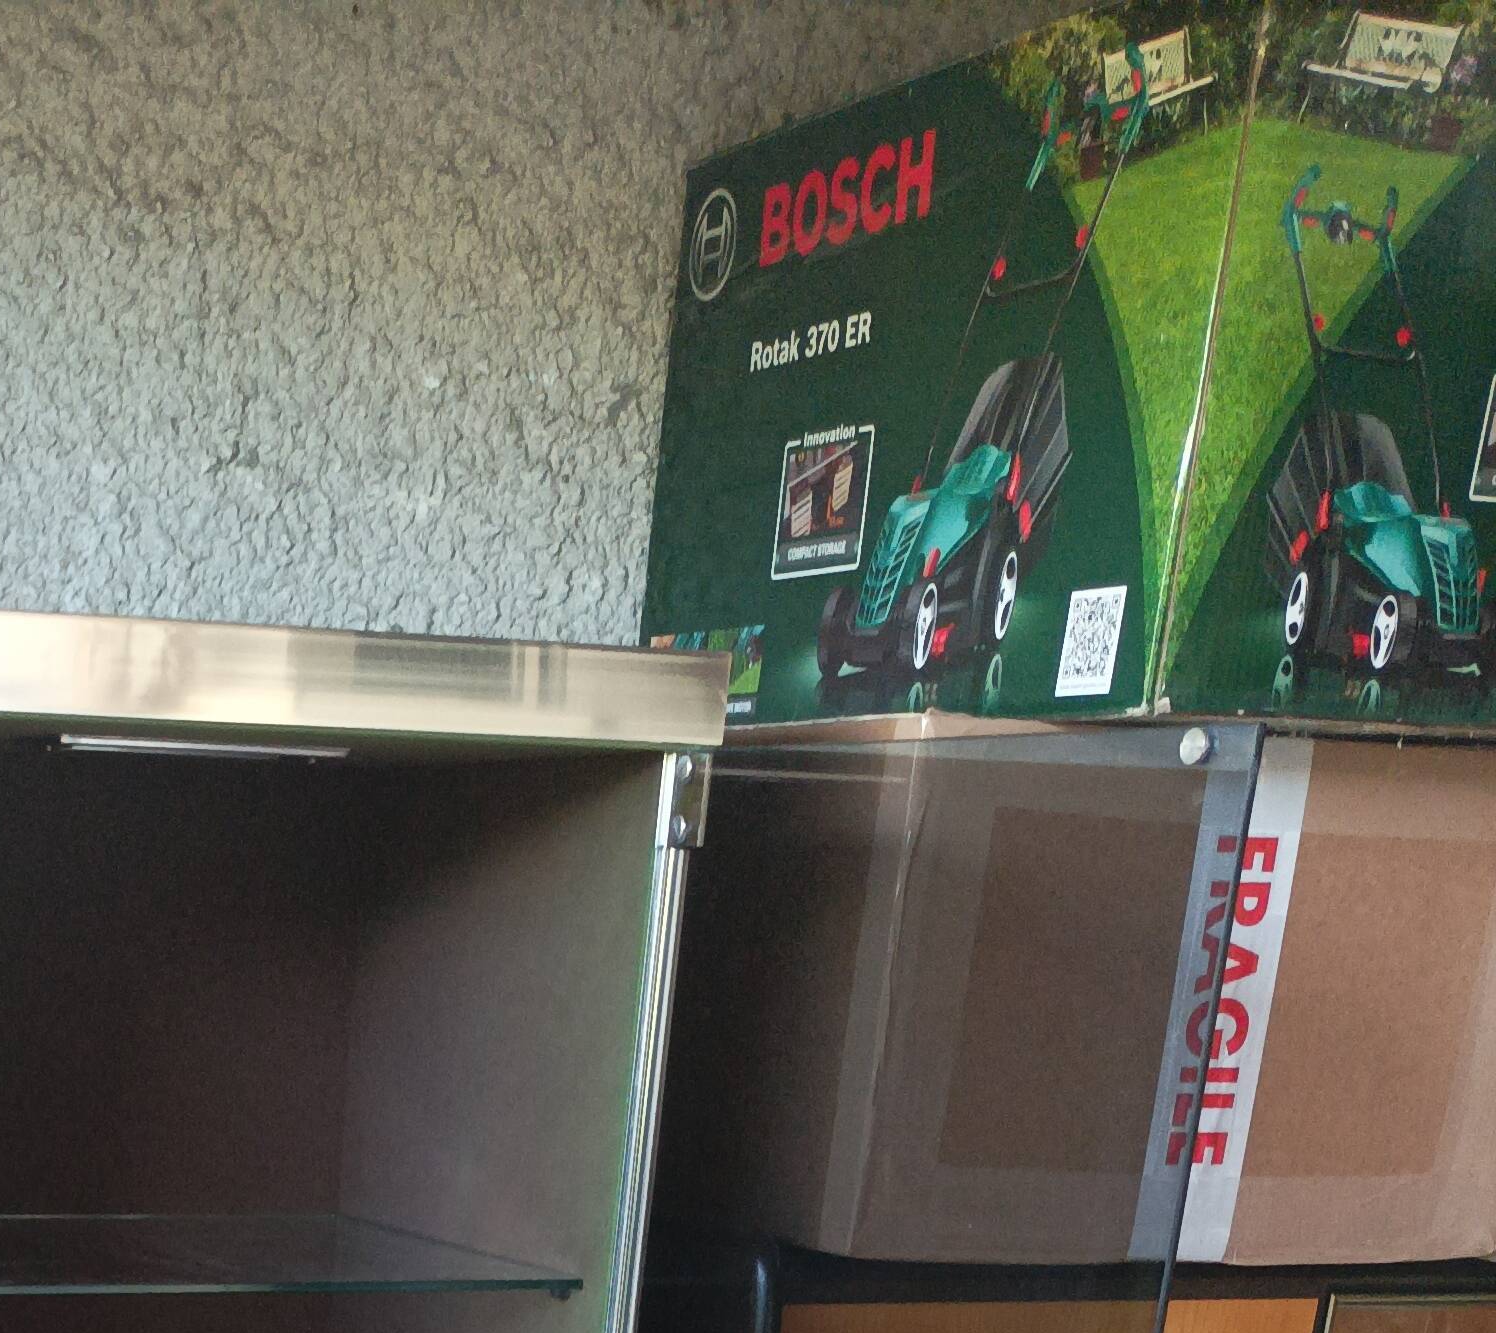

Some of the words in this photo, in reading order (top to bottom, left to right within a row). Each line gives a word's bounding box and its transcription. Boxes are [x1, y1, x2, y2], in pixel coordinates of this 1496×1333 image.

[759, 128, 936, 267] BOSCH
[750, 330, 800, 373] Rotak
[805, 319, 839, 357] 370
[845, 310, 872, 348] ER
[803, 424, 855, 448] Innovation
[1165, 836, 1279, 1166] FRAGILE
